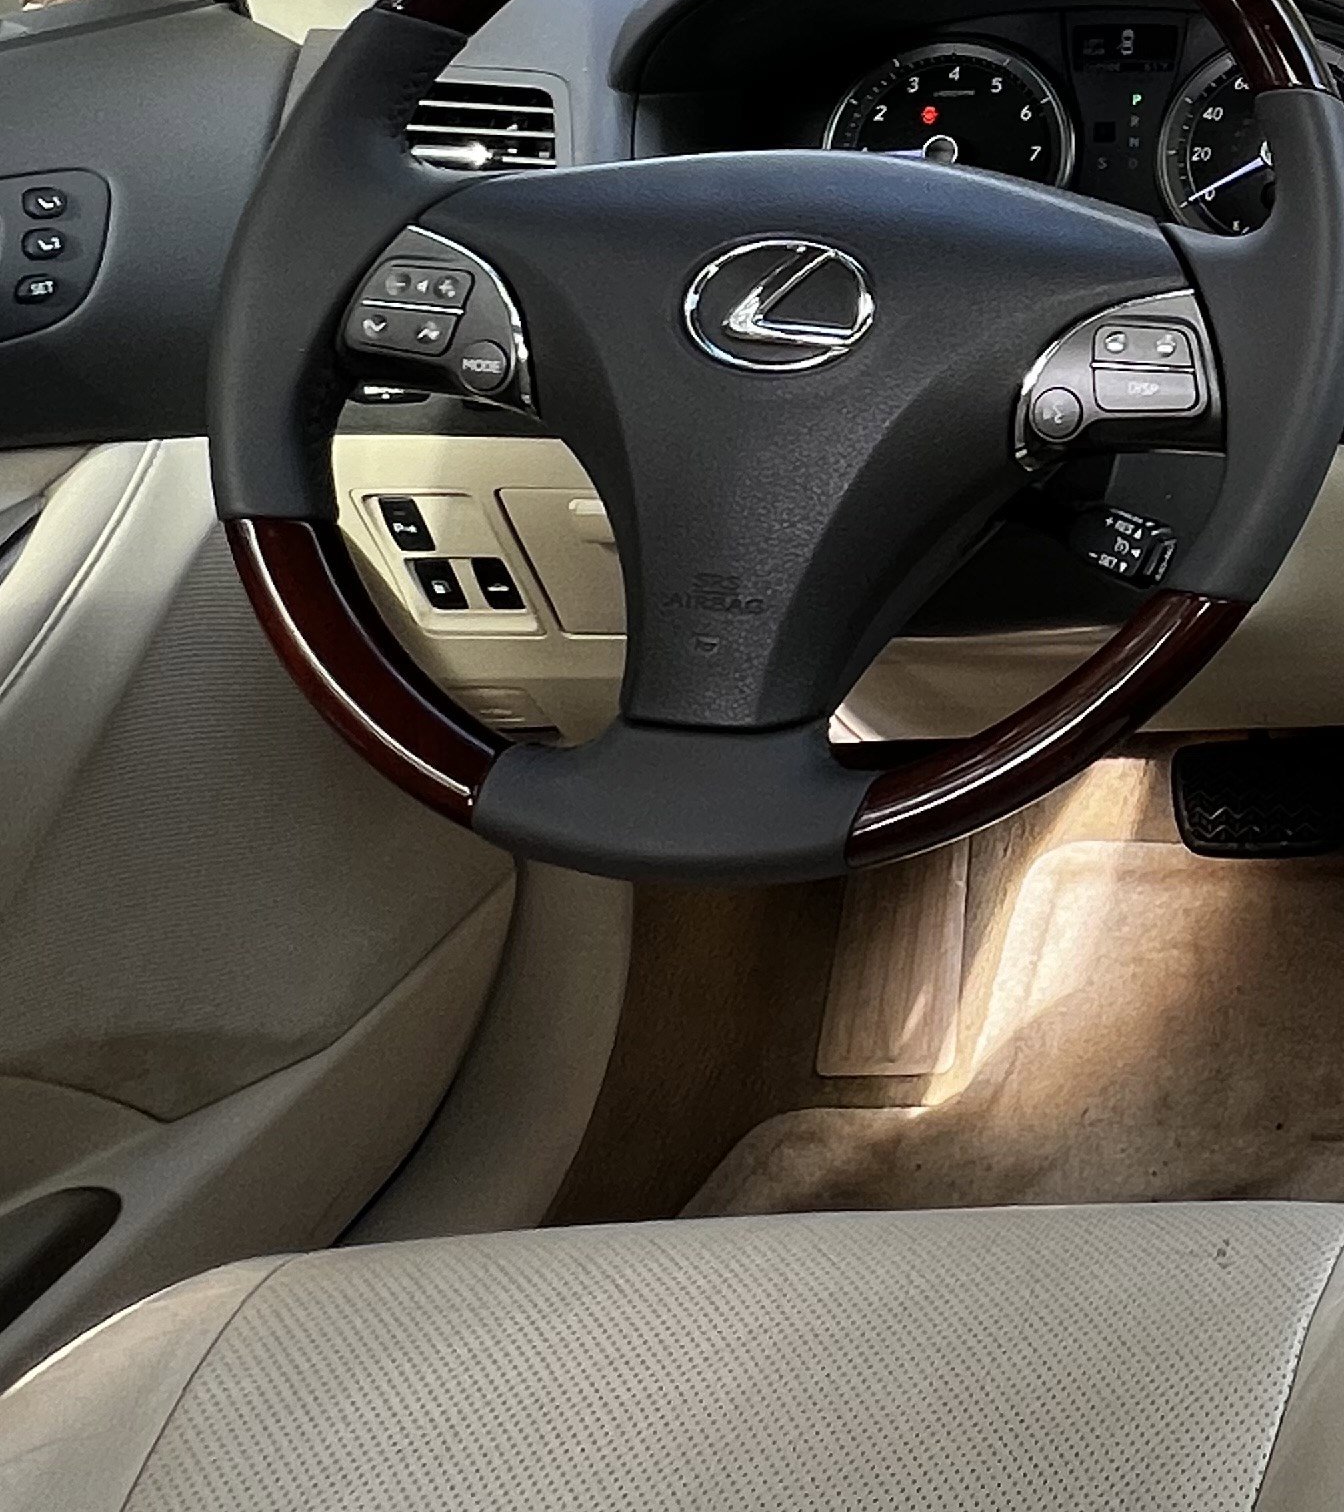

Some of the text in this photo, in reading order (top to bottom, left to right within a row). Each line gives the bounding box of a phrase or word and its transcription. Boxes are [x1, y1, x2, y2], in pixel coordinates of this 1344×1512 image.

[948, 66, 961, 81] 4
[907, 76, 920, 93] 3
[990, 76, 1003, 93] 5
[1132, 94, 1142, 106] P
[873, 104, 888, 122] 2
[1020, 104, 1032, 121] 6
[1202, 107, 1224, 122] 40
[1029, 145, 1042, 162] 7
[1191, 146, 1212, 162] 20
[1204, 188, 1216, 202] 0
